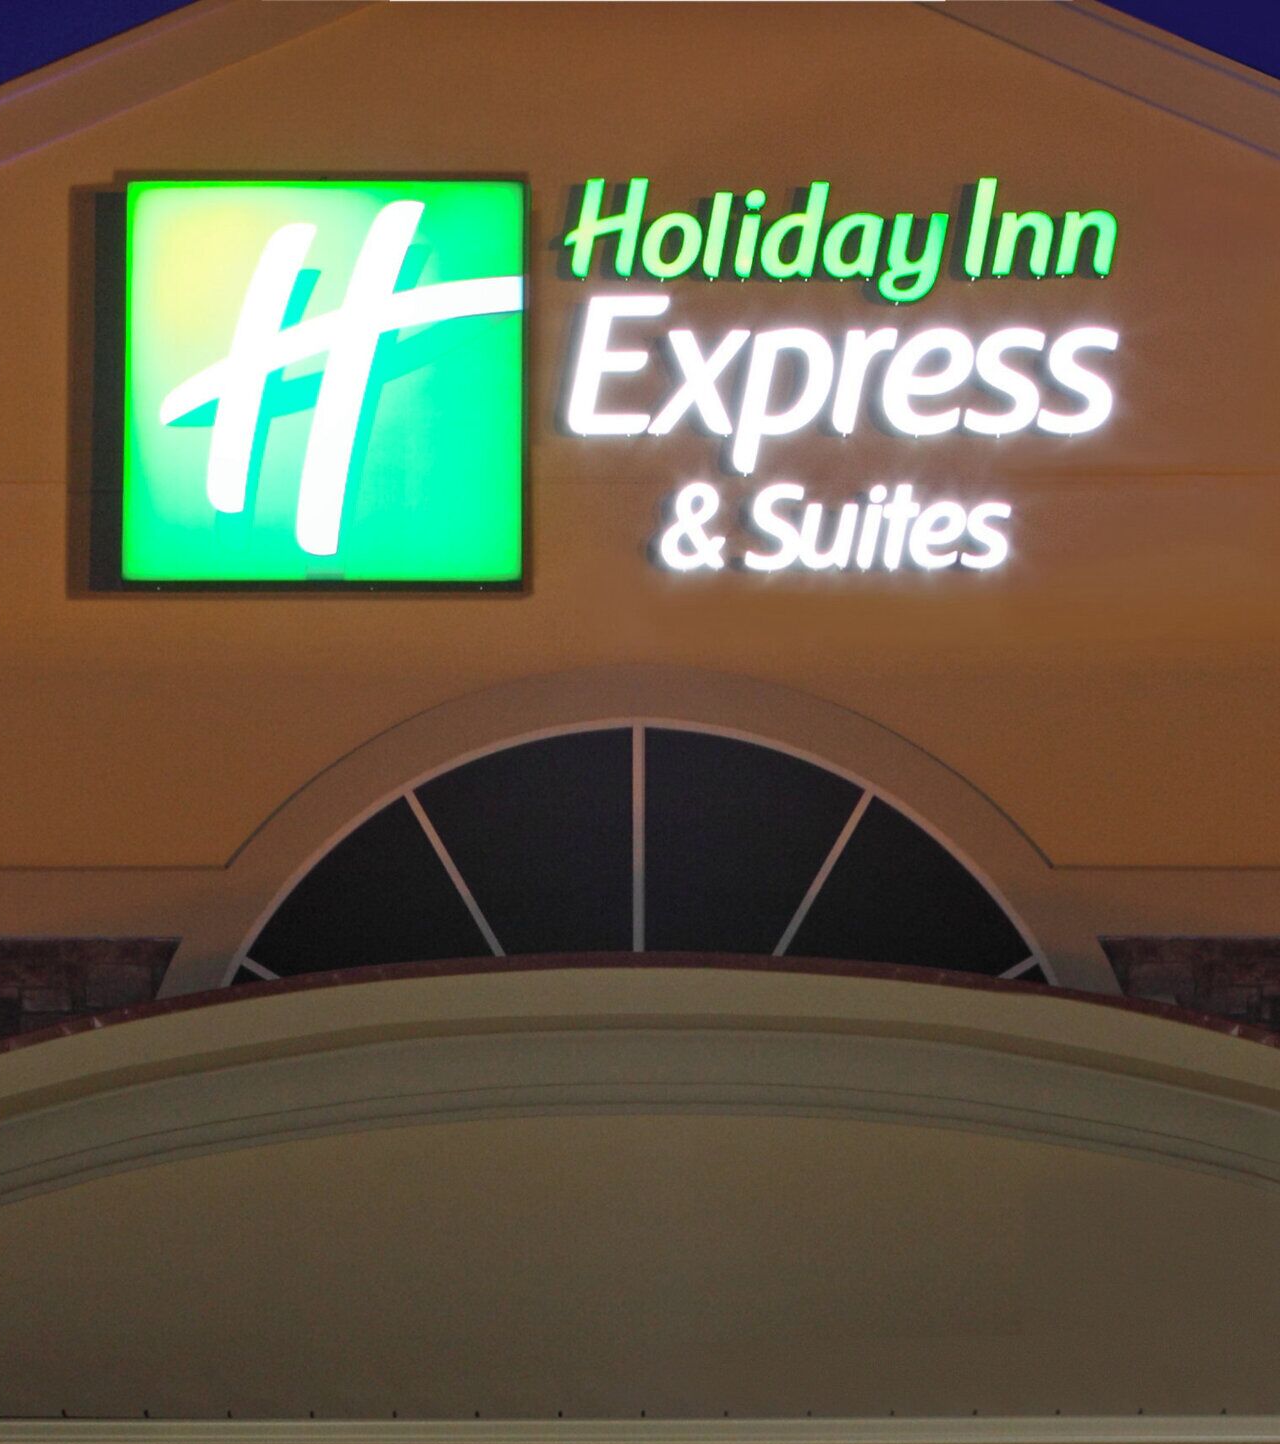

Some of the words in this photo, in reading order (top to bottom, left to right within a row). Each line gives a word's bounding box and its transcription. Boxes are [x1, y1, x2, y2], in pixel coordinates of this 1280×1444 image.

[563, 176, 950, 304] Holiday
[963, 176, 1118, 280] Inn
[567, 294, 1120, 476] Express
[660, 480, 727, 574] &
[743, 482, 1012, 574] Suites
